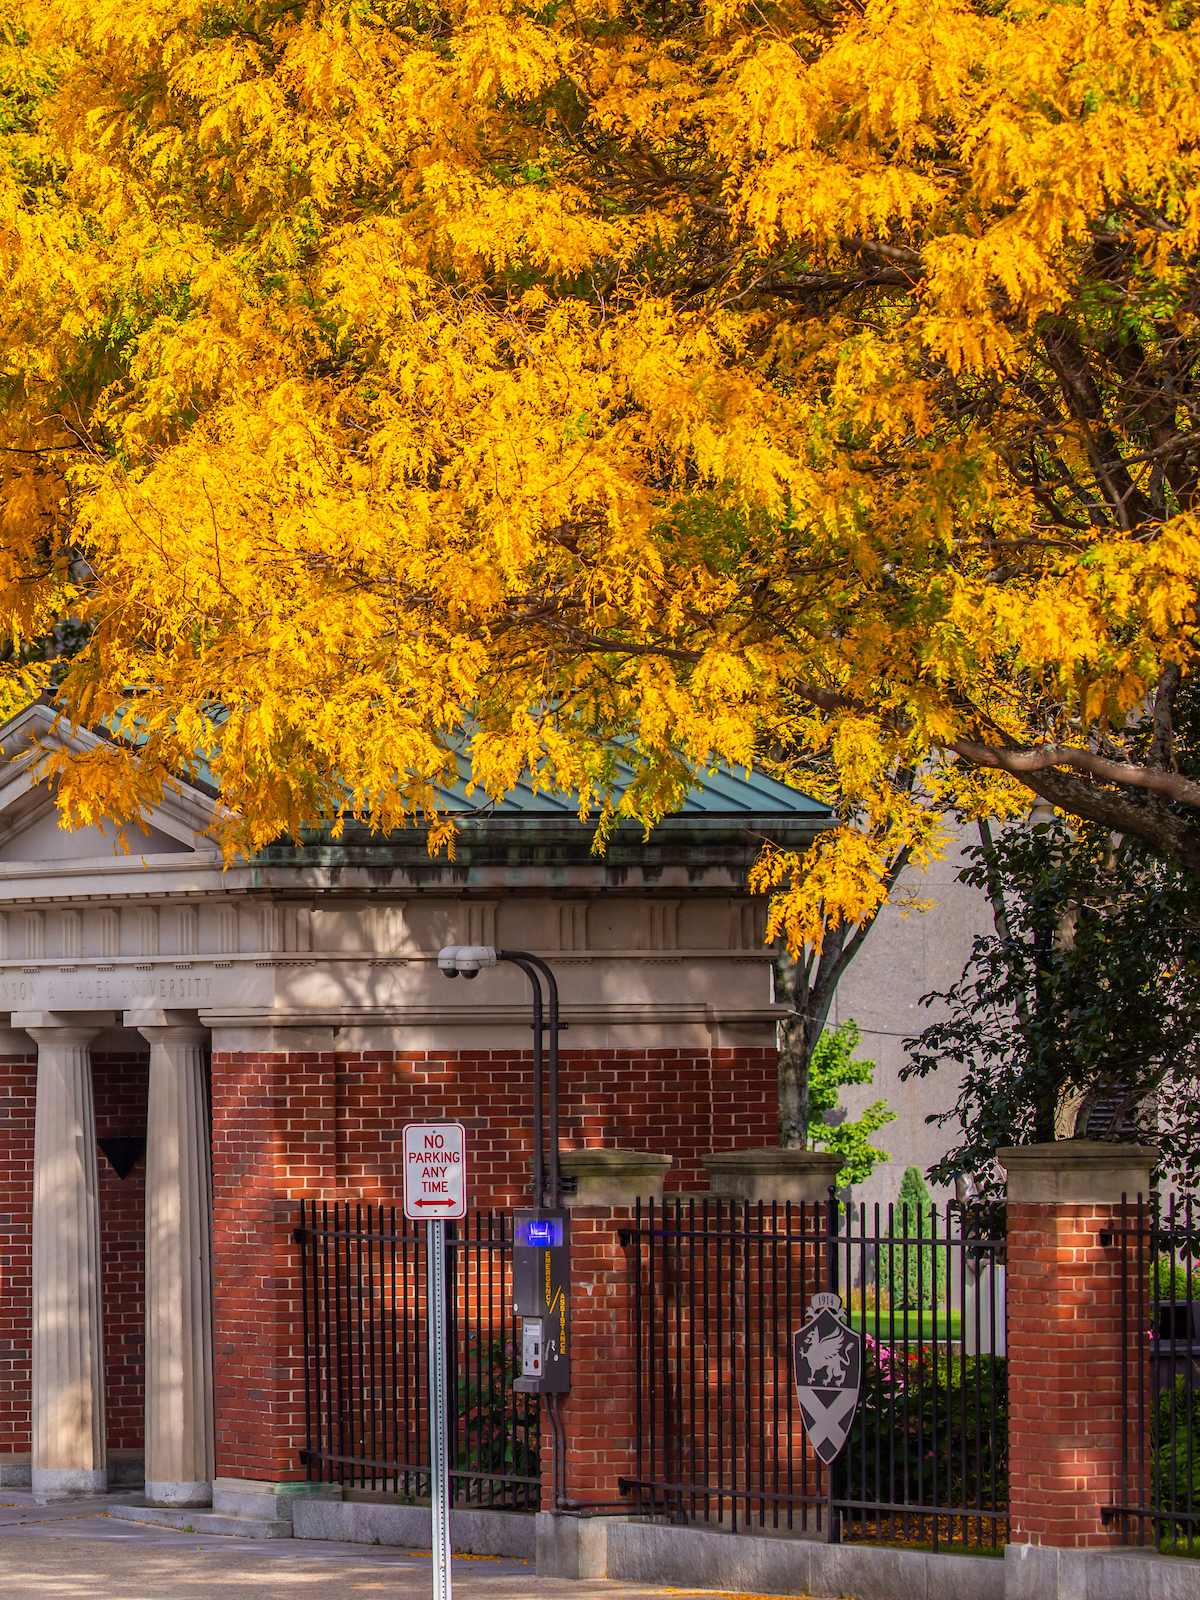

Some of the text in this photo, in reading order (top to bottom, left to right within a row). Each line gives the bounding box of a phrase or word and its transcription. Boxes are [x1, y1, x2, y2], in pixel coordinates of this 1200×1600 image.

[121, 977, 212, 999] UNIVERSITY
[424, 1134, 444, 1149] NO
[408, 1151, 460, 1164] PARKING
[422, 1166, 448, 1178] ANY
[422, 1181, 448, 1193] TIME
[544, 1251, 552, 1307] EMERGENCY
[817, 1295, 834, 1306] 1914
[559, 1293, 567, 1355] ASSISTANCE
